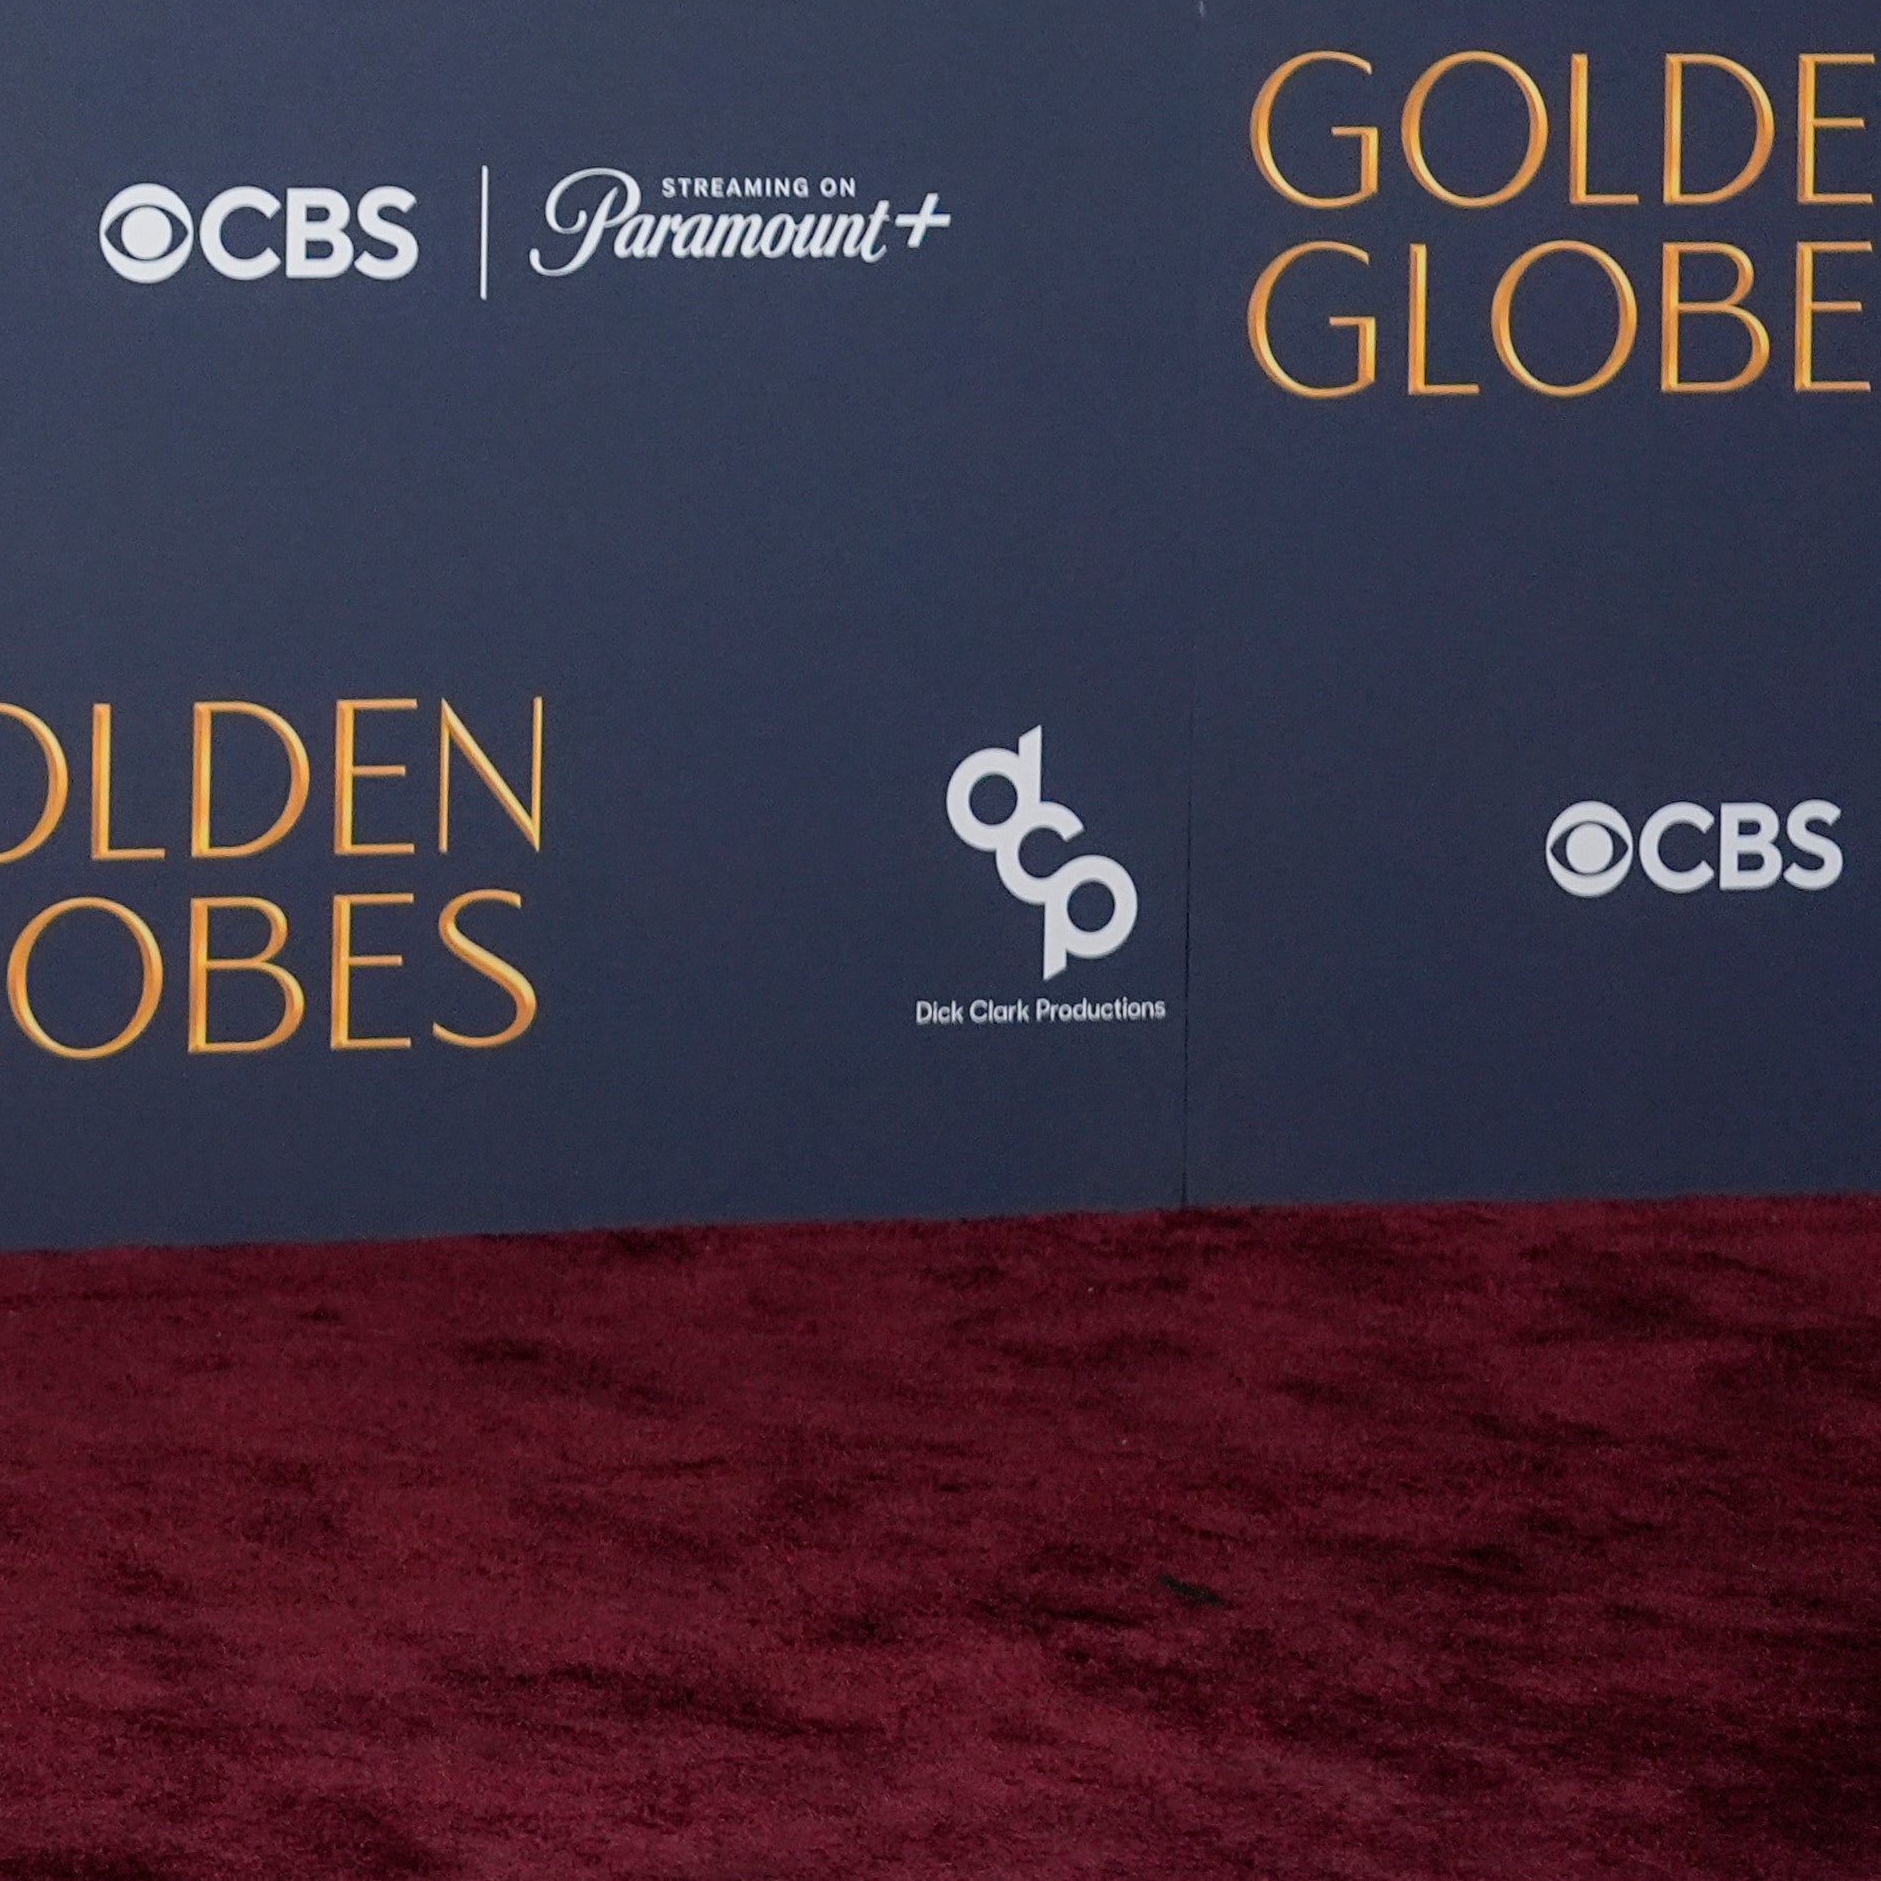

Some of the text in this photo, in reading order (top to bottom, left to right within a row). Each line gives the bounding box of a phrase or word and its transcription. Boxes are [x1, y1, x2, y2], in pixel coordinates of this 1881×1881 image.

[661, 176, 856, 199] STREAMING ON
[200, 185, 419, 281] CBS
[1639, 799, 1844, 894] CBS
[915, 996, 1167, 1026] Dick Clark Productions
